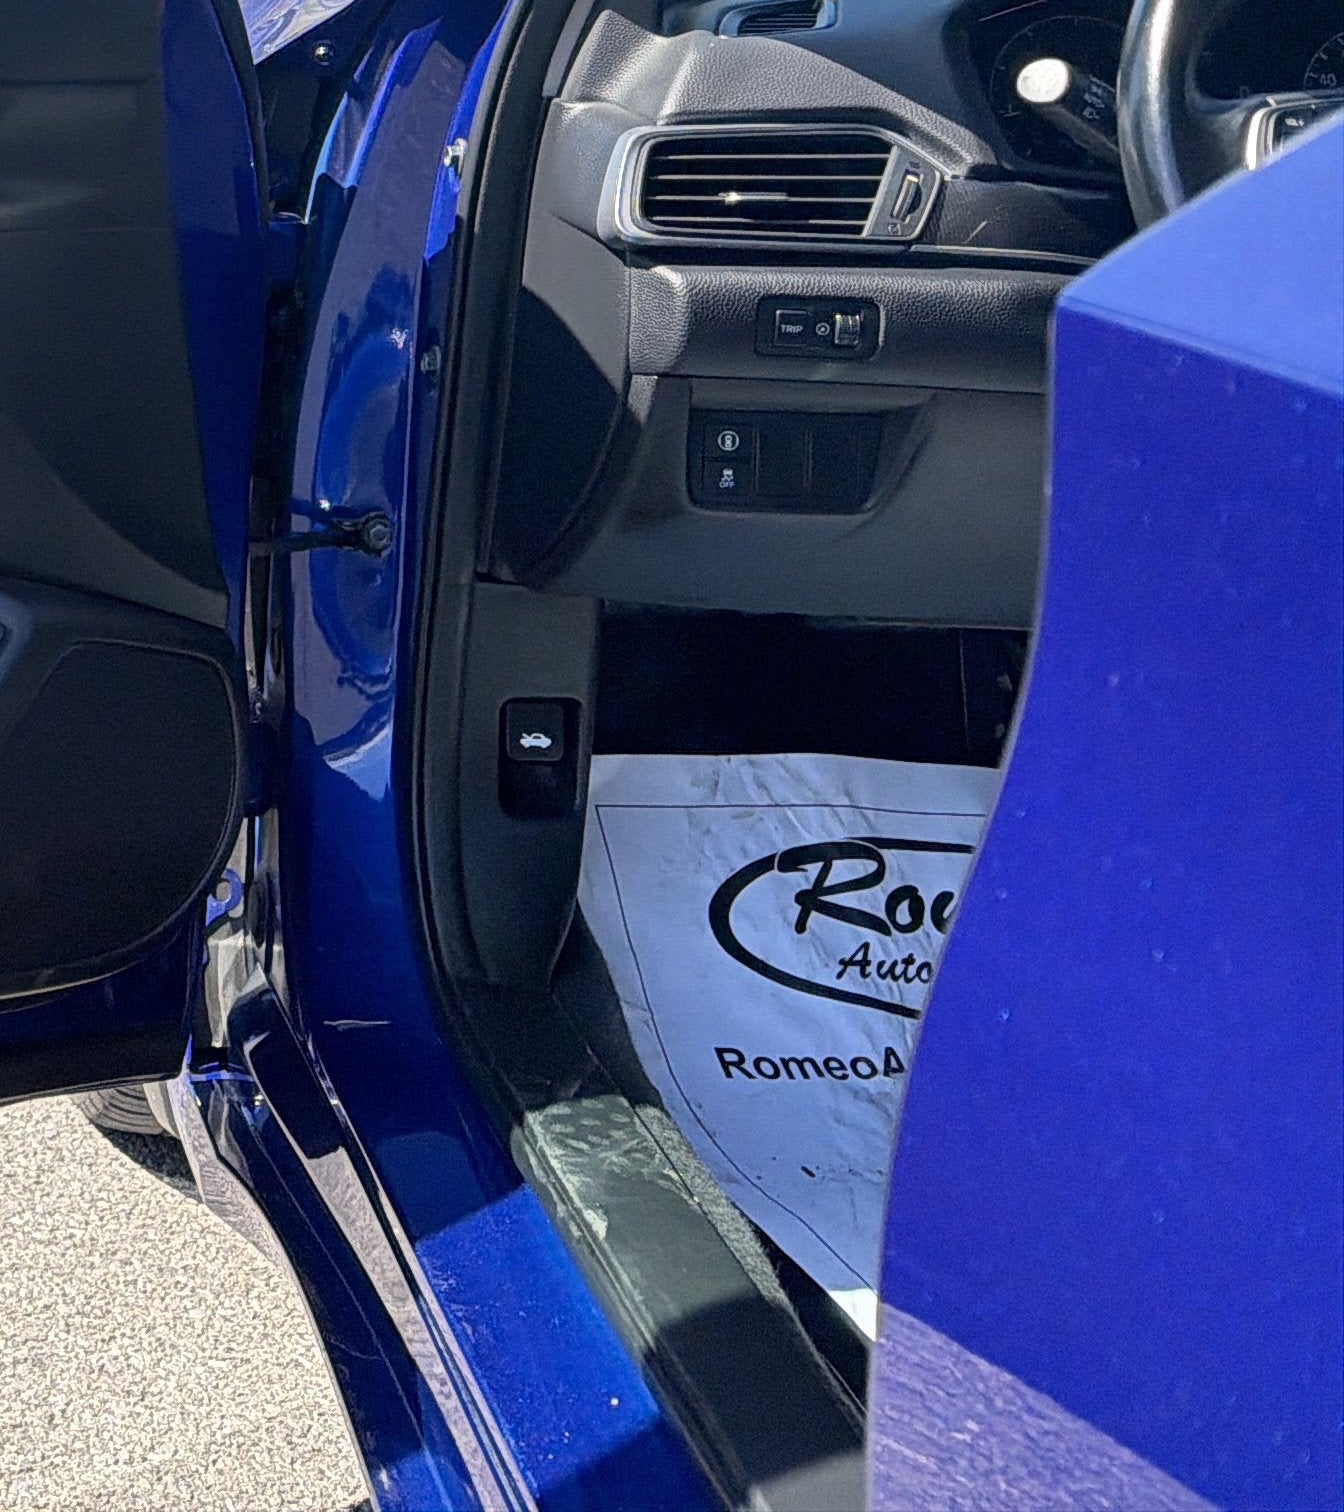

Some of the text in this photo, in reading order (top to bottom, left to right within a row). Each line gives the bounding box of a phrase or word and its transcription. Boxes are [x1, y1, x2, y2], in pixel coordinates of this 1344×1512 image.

[780, 324, 804, 334] TRIP
[718, 480, 735, 488] OFF
[776, 840, 955, 937] Ro
[835, 941, 934, 985] Auto
[714, 1046, 906, 1080] RomeoA
